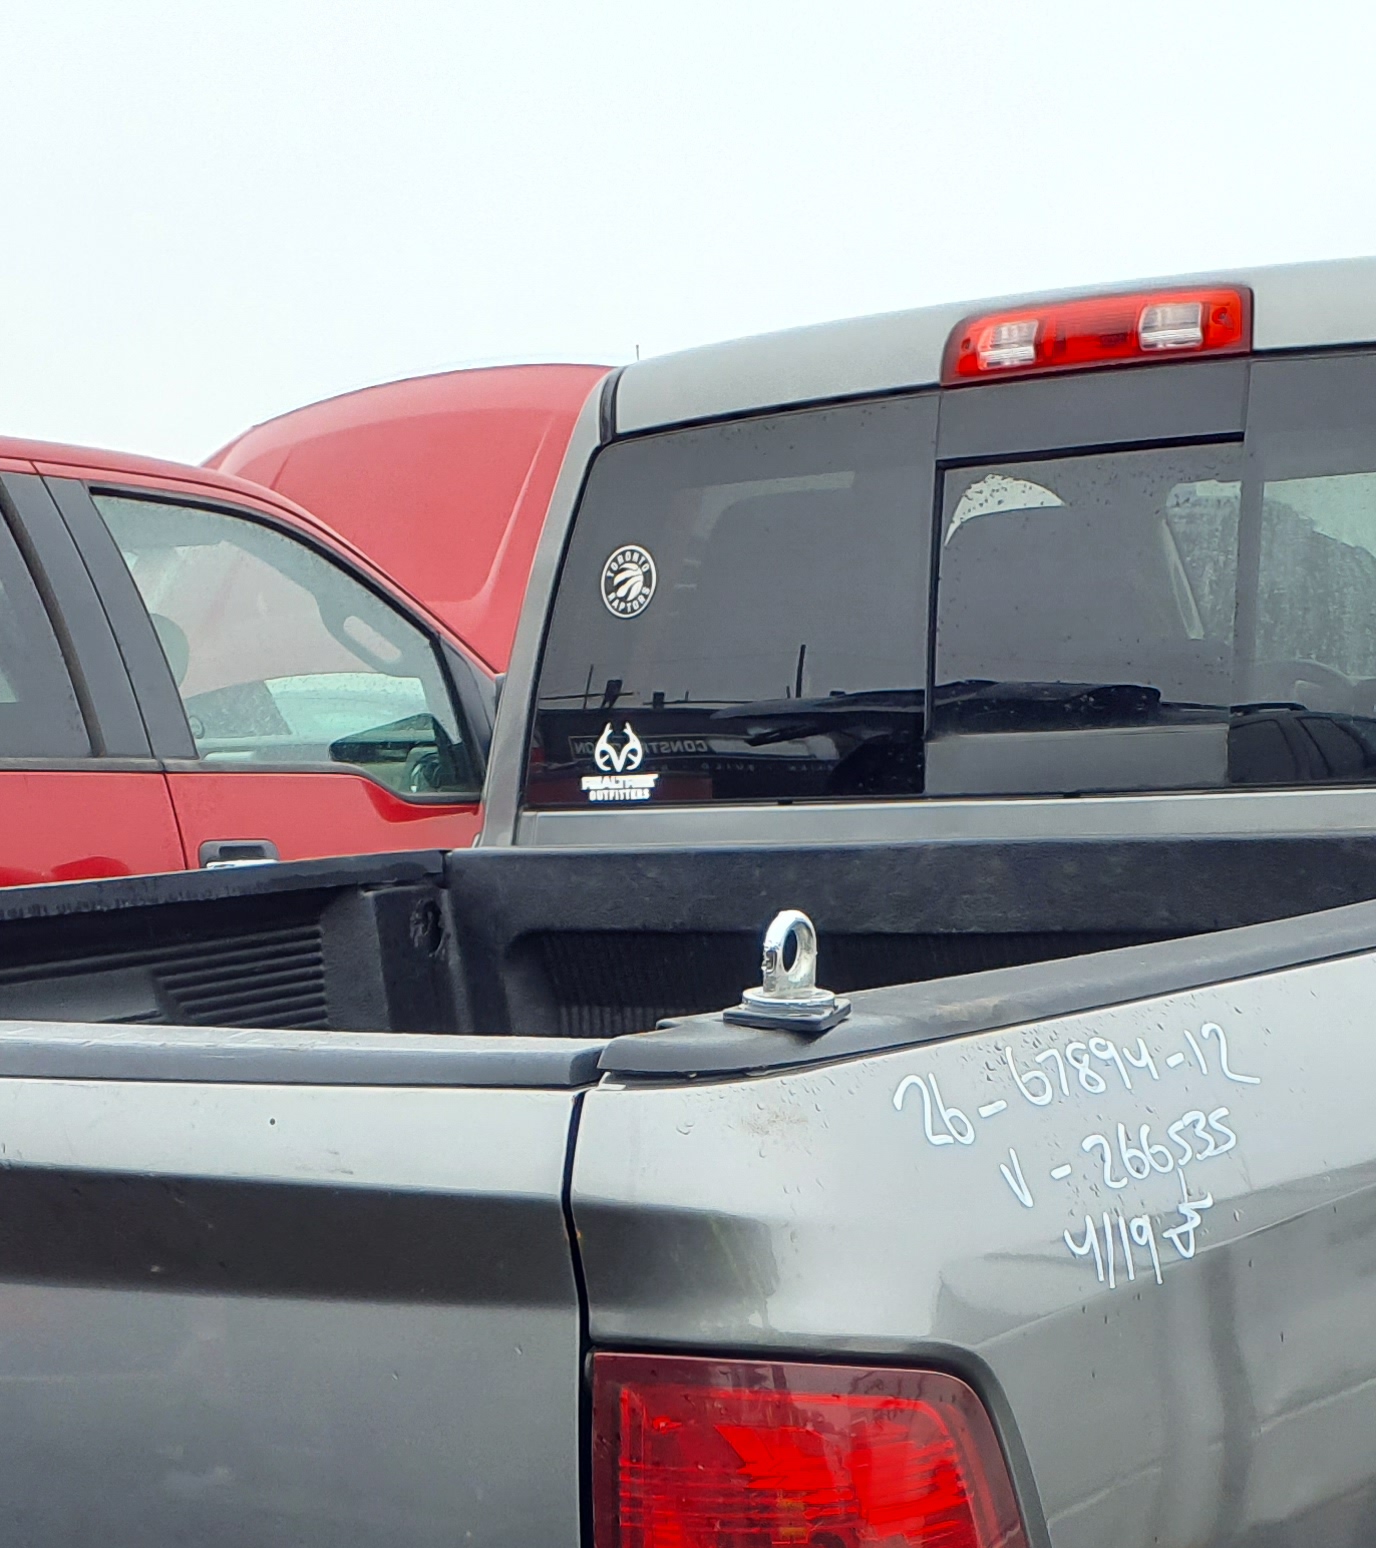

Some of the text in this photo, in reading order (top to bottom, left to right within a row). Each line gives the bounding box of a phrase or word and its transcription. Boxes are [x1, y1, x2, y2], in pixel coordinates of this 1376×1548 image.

[606, 551, 650, 577] TORONTO
[607, 586, 650, 613] RAPTORS
[589, 788, 650, 801] OUTFITTERS
